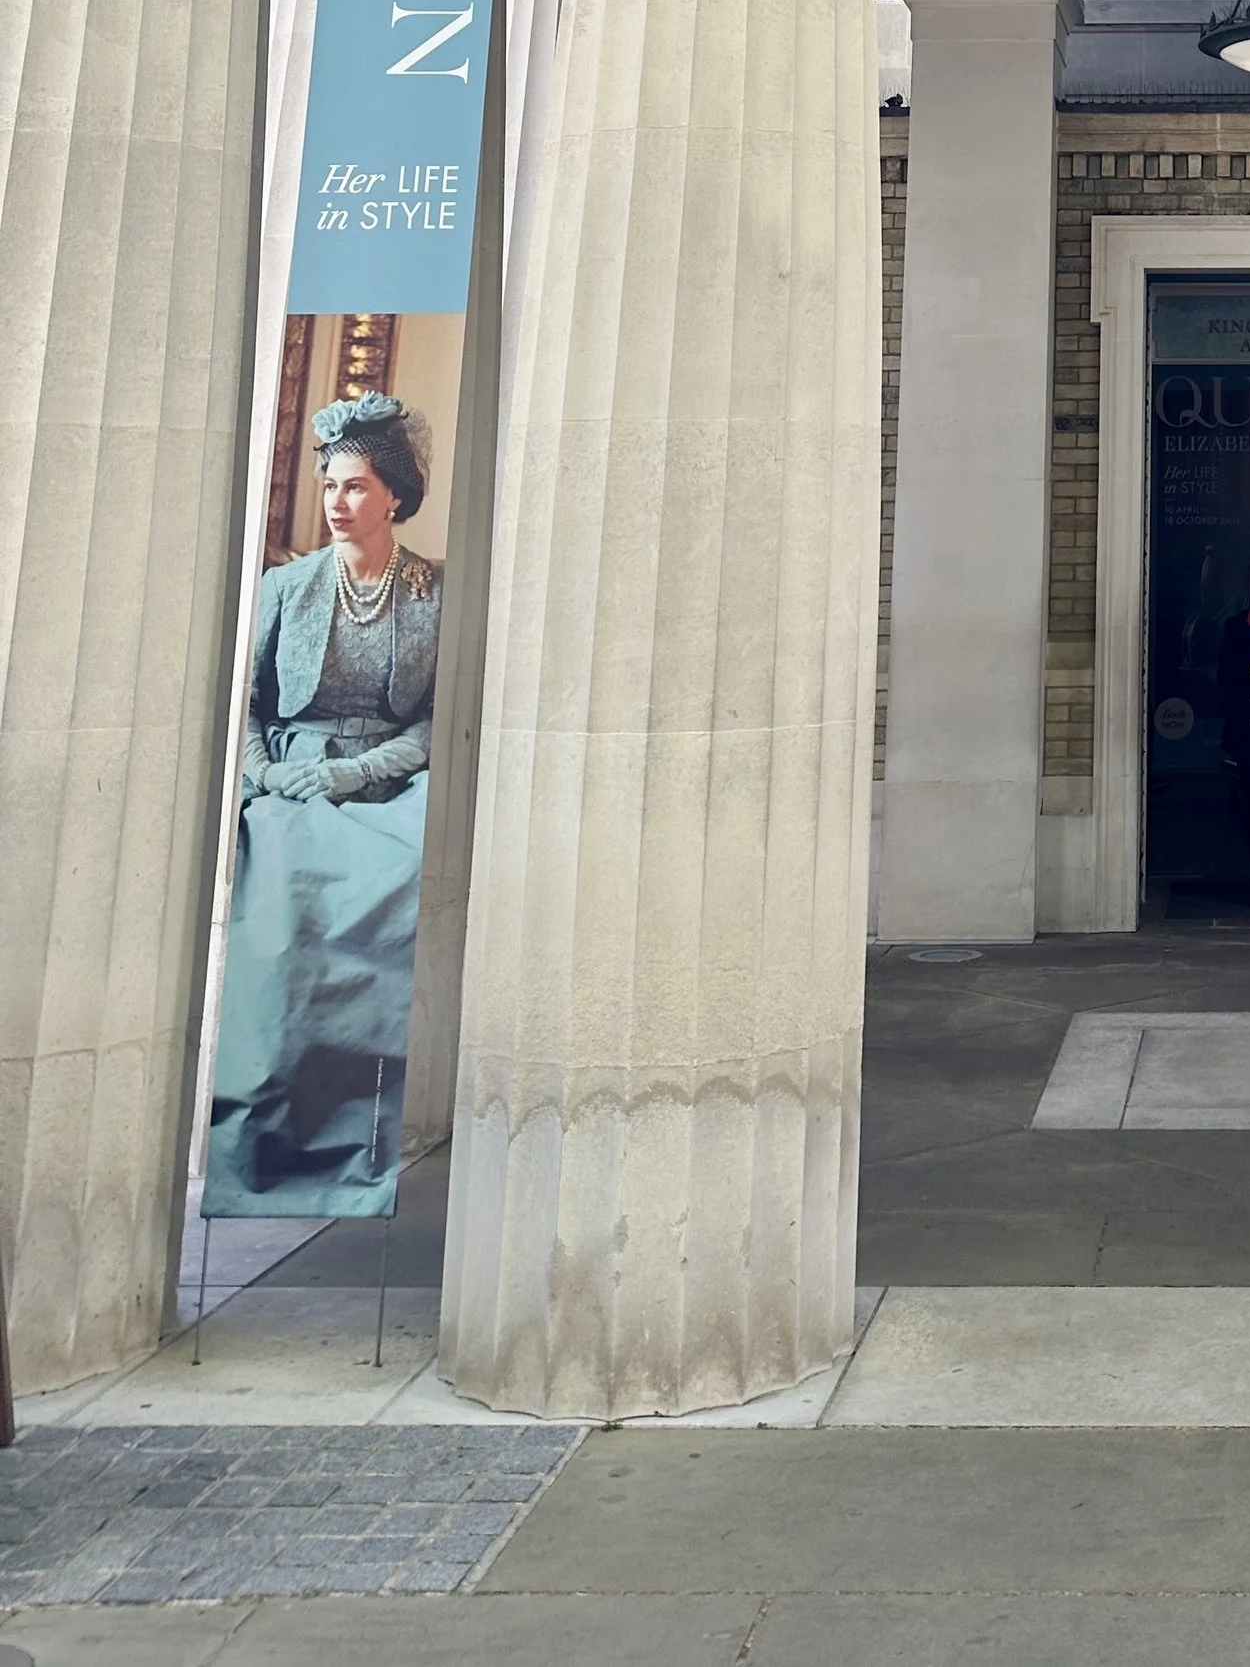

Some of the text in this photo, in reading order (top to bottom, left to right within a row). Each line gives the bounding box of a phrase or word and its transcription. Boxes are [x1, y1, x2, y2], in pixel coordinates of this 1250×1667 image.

[318, 164, 460, 194] Her LIFE
[317, 200, 456, 230] in STYLE
[1163, 465, 1219, 479] Her LIFE
[1180, 481, 1219, 494] STYLE
